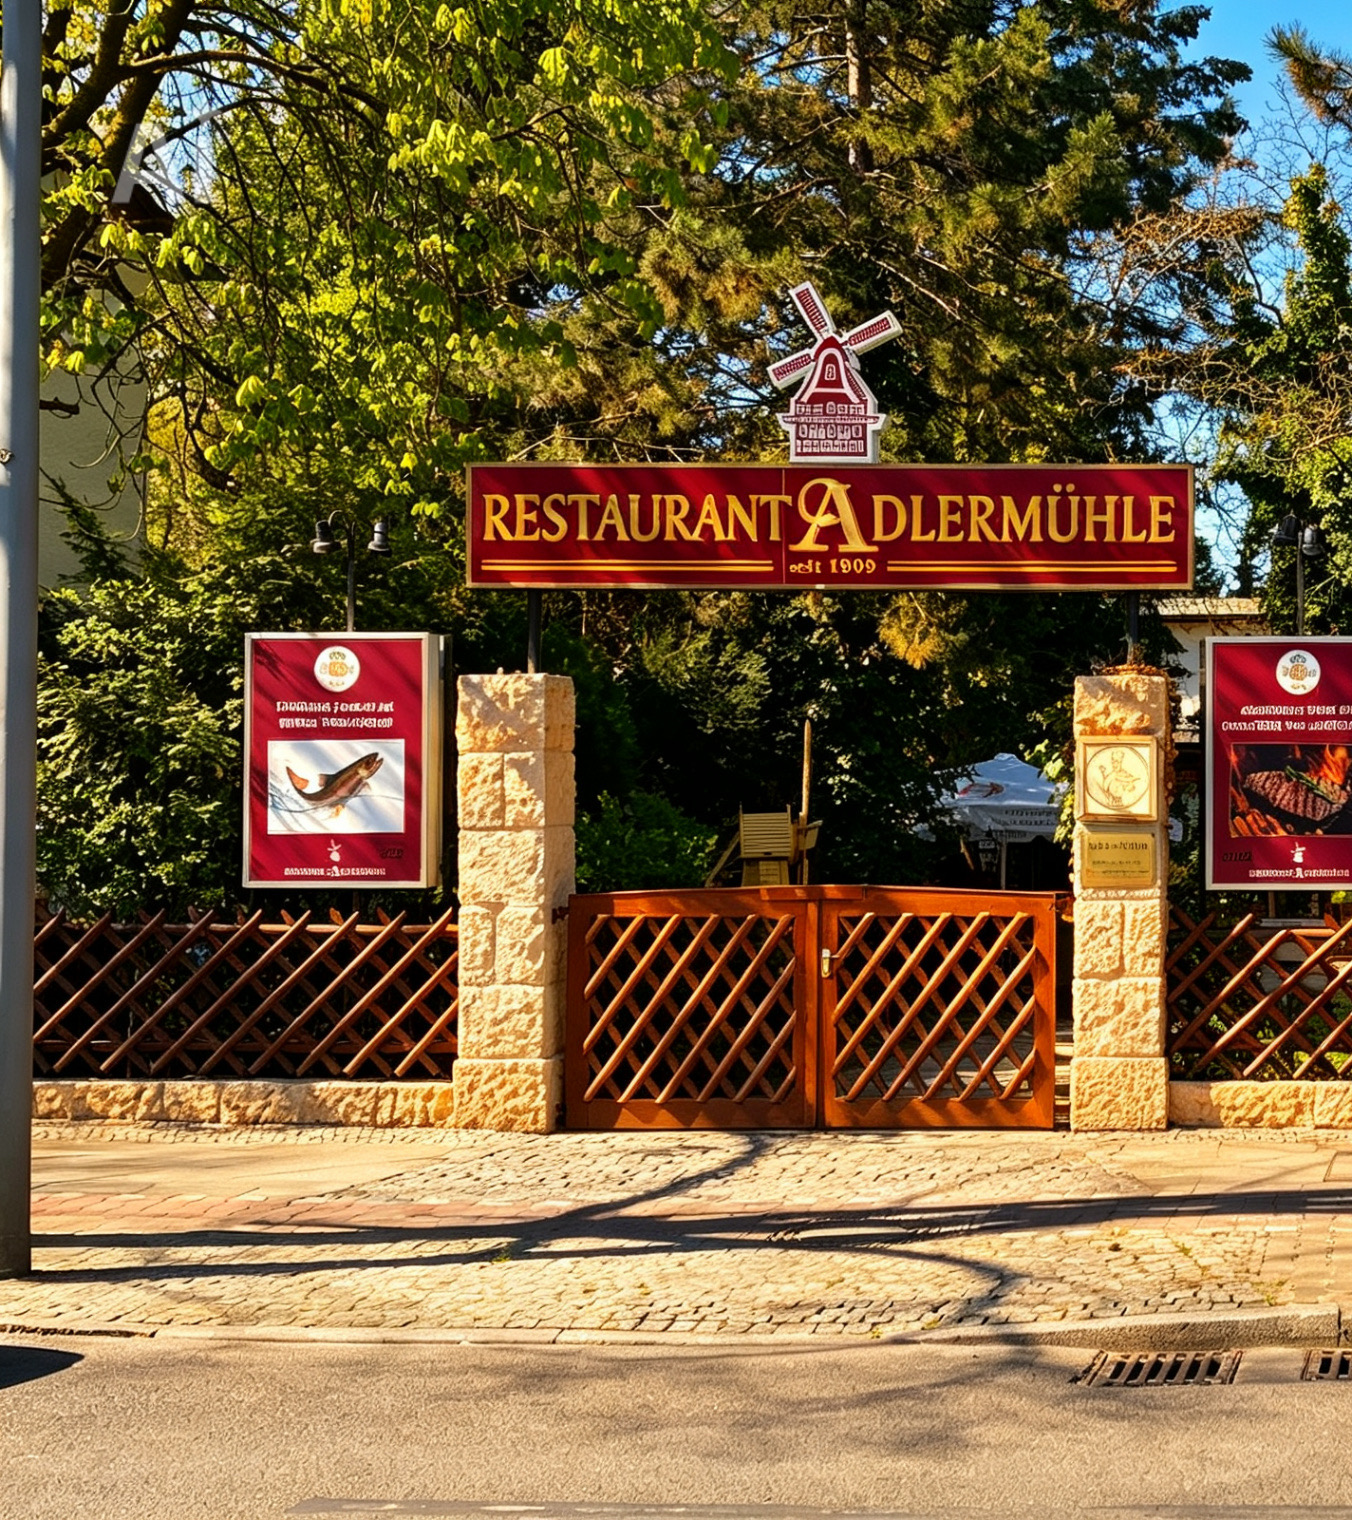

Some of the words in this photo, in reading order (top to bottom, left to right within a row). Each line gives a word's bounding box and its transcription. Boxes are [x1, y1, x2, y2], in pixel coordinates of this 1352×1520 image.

[482, 493, 792, 543] RESTAURANT
[788, 477, 1176, 553] ADLERMÜHLE
[830, 558, 876, 574] 1909
